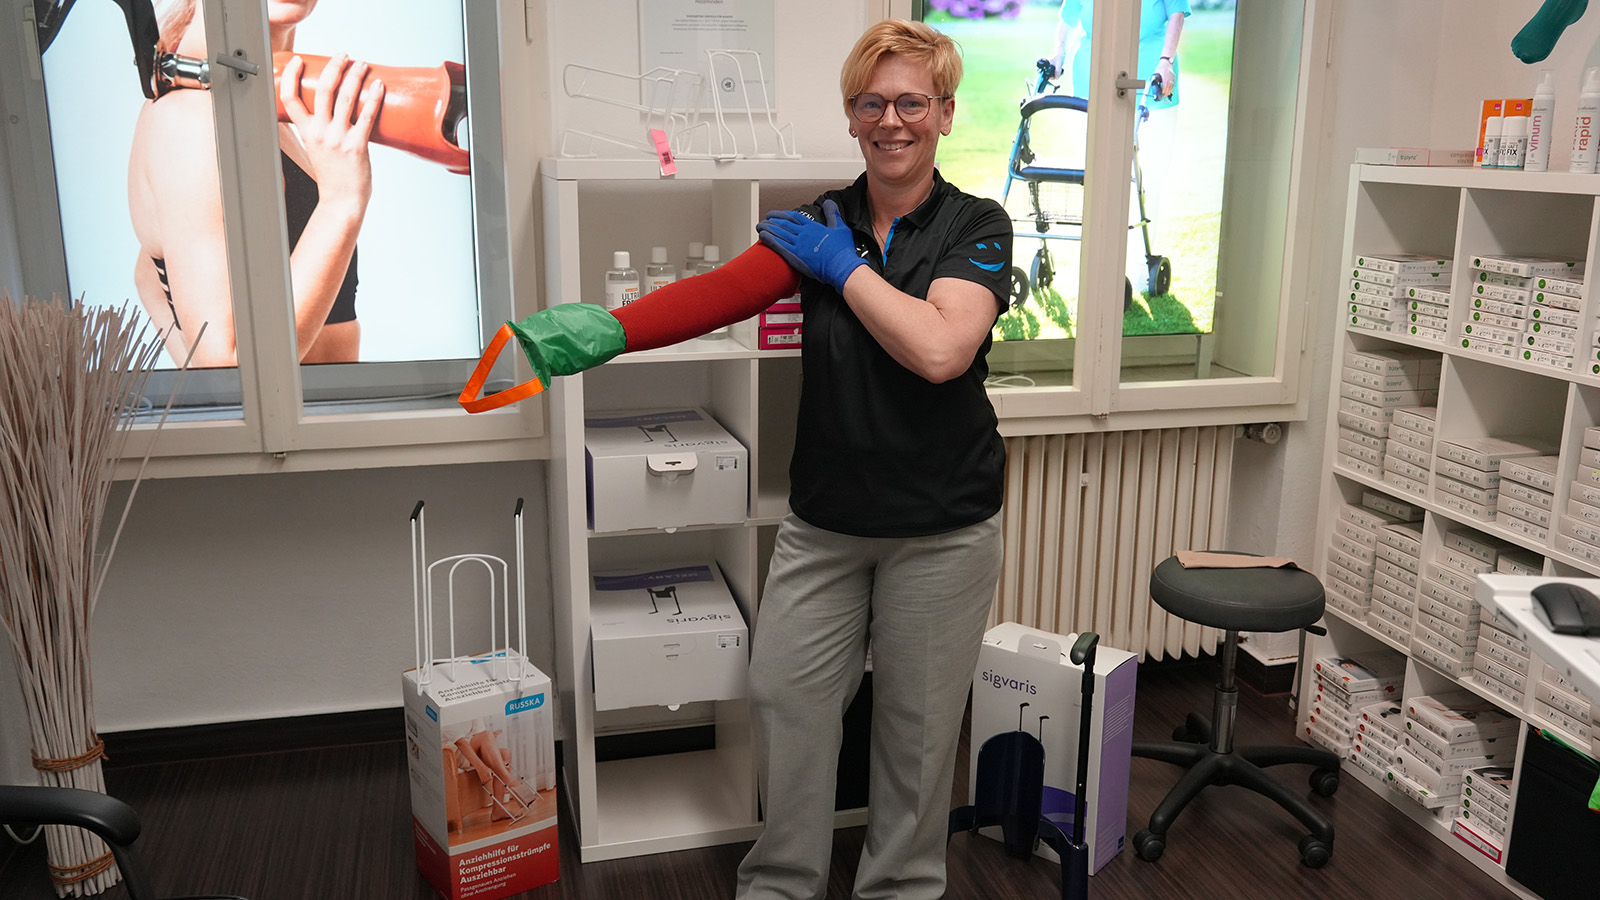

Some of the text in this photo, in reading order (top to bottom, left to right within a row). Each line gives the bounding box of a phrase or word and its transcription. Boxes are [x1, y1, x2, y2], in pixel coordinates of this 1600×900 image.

[1529, 115, 1542, 152] vinum
[1579, 116, 1592, 151] rapid
[666, 613, 731, 624] sigvaris
[982, 669, 1037, 695] sigvaris
[509, 697, 541, 711] RUSSKA
[459, 844, 519, 867] Anziehhilfe für
[459, 843, 551, 876] Kompressionsstrümpfe
[460, 866, 507, 884] Ausziehbar
[460, 872, 517, 893] Passgenaues Anziehen
[460, 882, 507, 899] ohne Anstrengung
